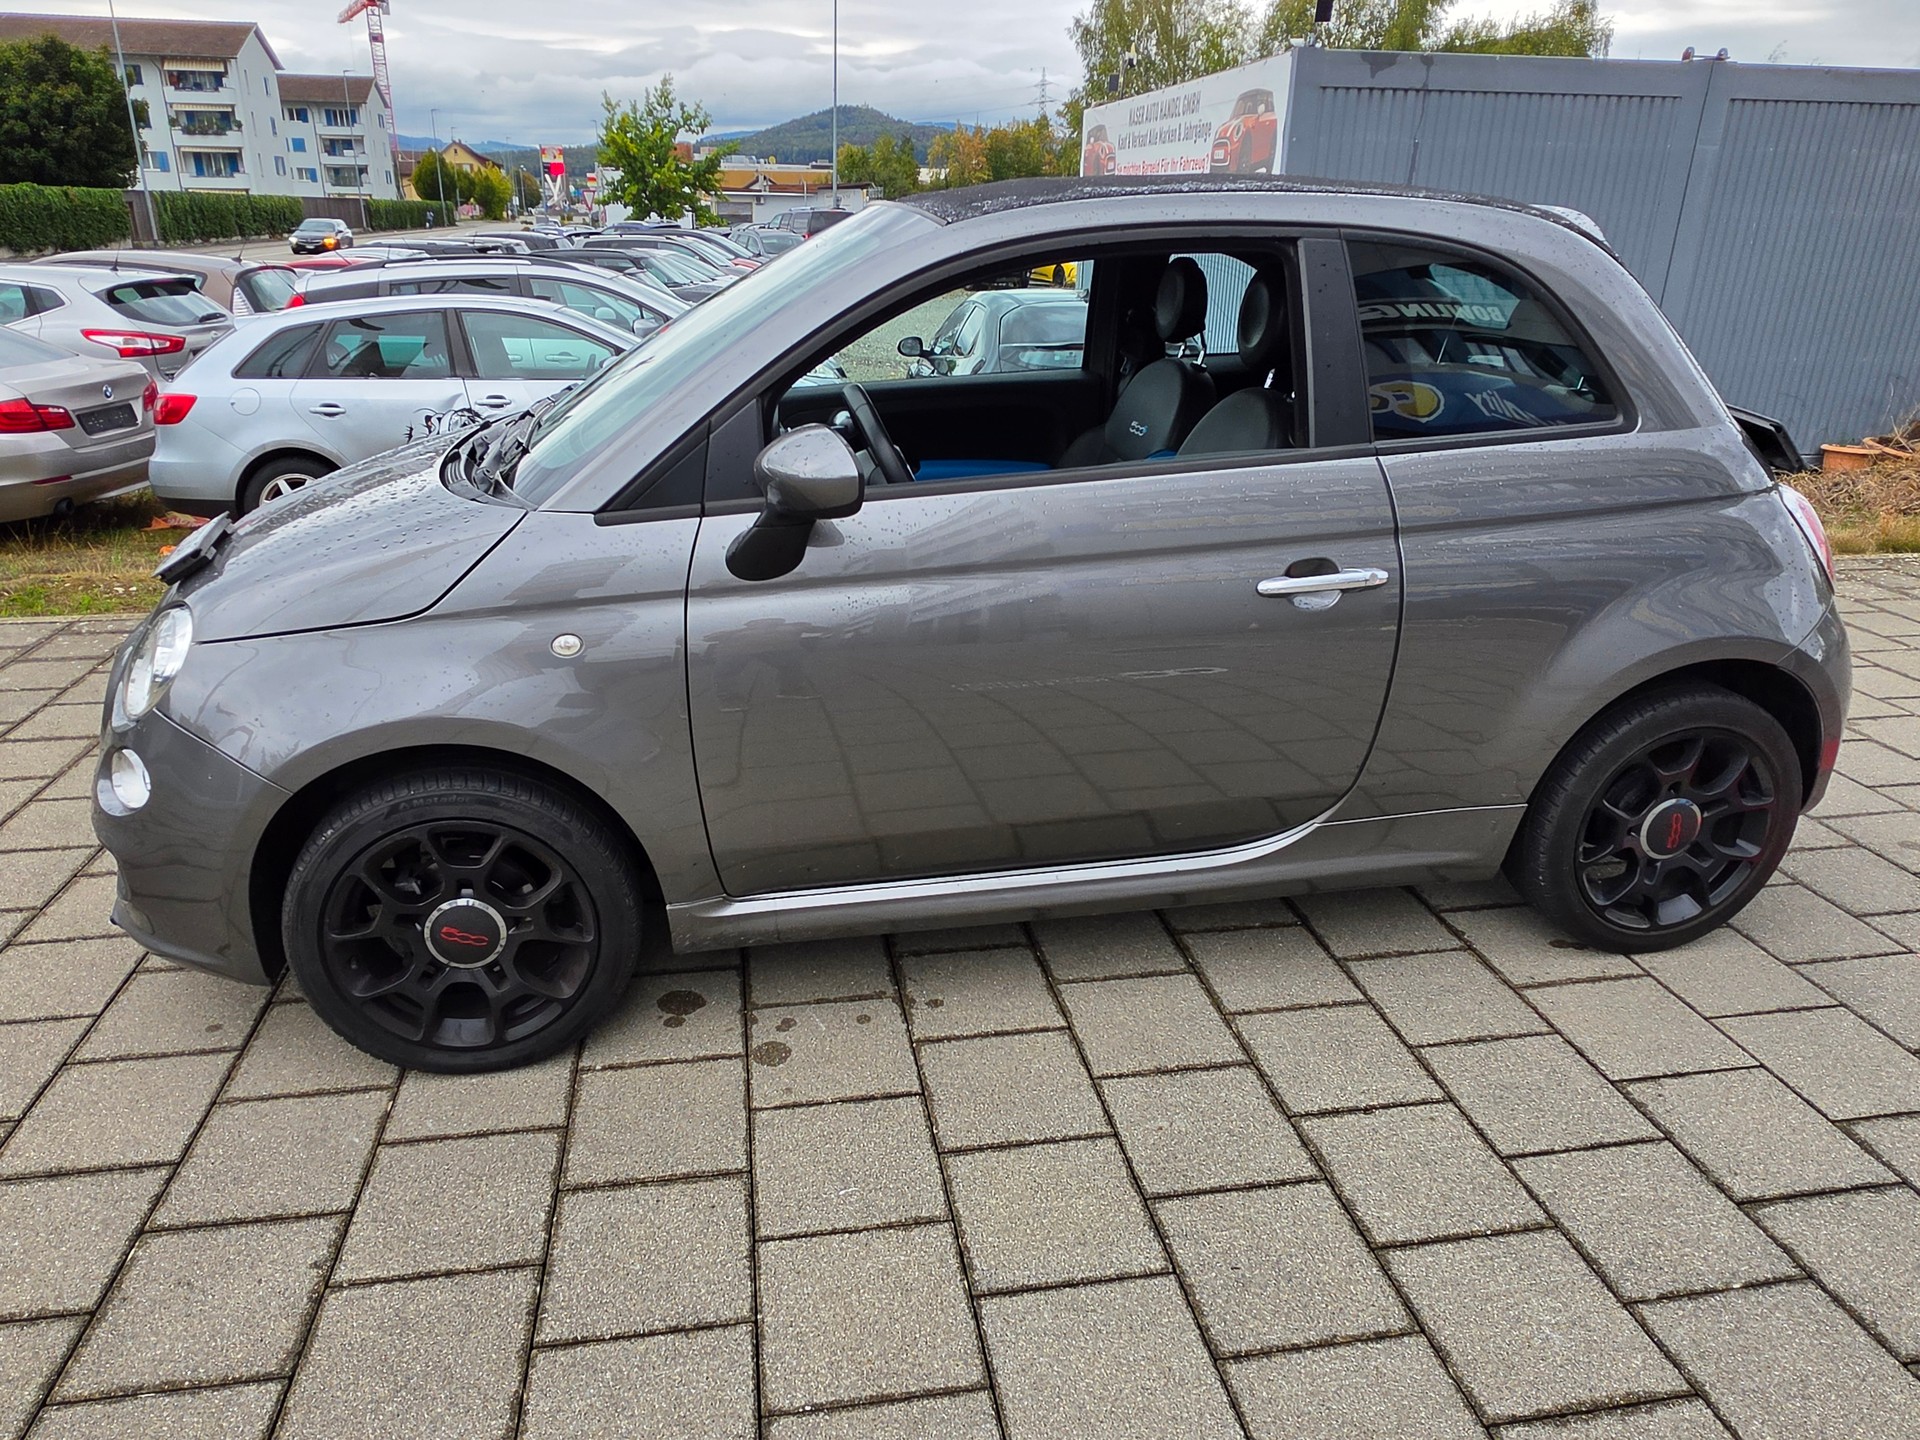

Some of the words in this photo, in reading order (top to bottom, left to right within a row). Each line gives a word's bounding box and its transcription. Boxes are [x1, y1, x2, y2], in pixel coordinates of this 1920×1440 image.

[1145, 102, 1158, 123] AUTO
[1160, 97, 1181, 120] HANDEL
[1118, 134, 1127, 150] Kauf
[1131, 129, 1148, 148] Verkauf
[1159, 125, 1177, 144] Marken
[1183, 119, 1211, 144] Jahrgänge
[440, 926, 489, 946] 500
